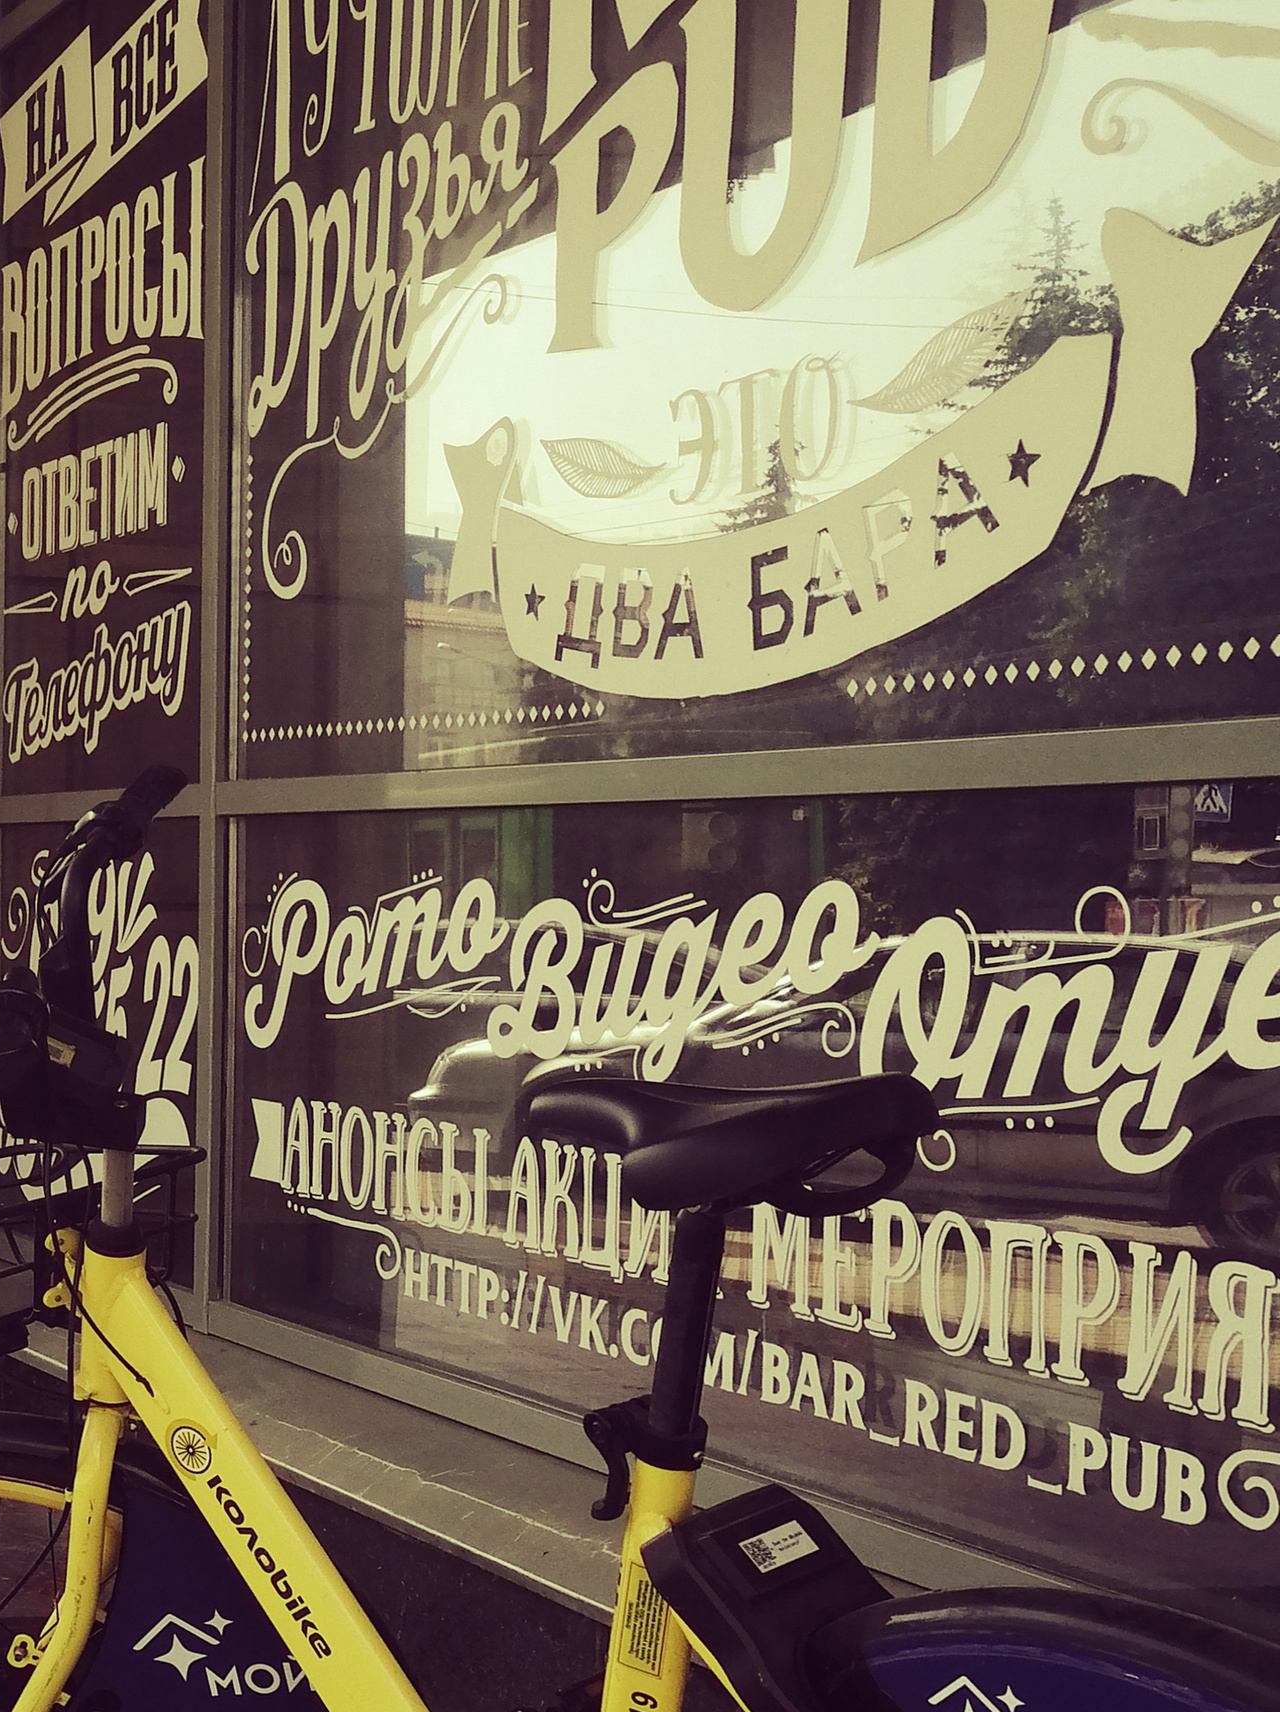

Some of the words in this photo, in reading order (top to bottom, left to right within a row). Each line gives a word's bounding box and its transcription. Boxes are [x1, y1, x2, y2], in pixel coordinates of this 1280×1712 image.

[25, 65, 69, 192] НА
[111, 1, 179, 155] ВСЕ
[0, 156, 205, 420] ВОПРОСЫ
[22, 422, 168, 561] ОТВЕТИМ
[669, 353, 840, 505] ЭТО
[554, 562, 704, 669] ДВА
[747, 451, 1000, 651] БАРА
[281, 1096, 491, 1235] АНОНСЫ
[503, 1133, 724, 1300] АКЦИ
[404, 1247, 1208, 1526] HTTP://VK.CM/BAR_RED_PUB
